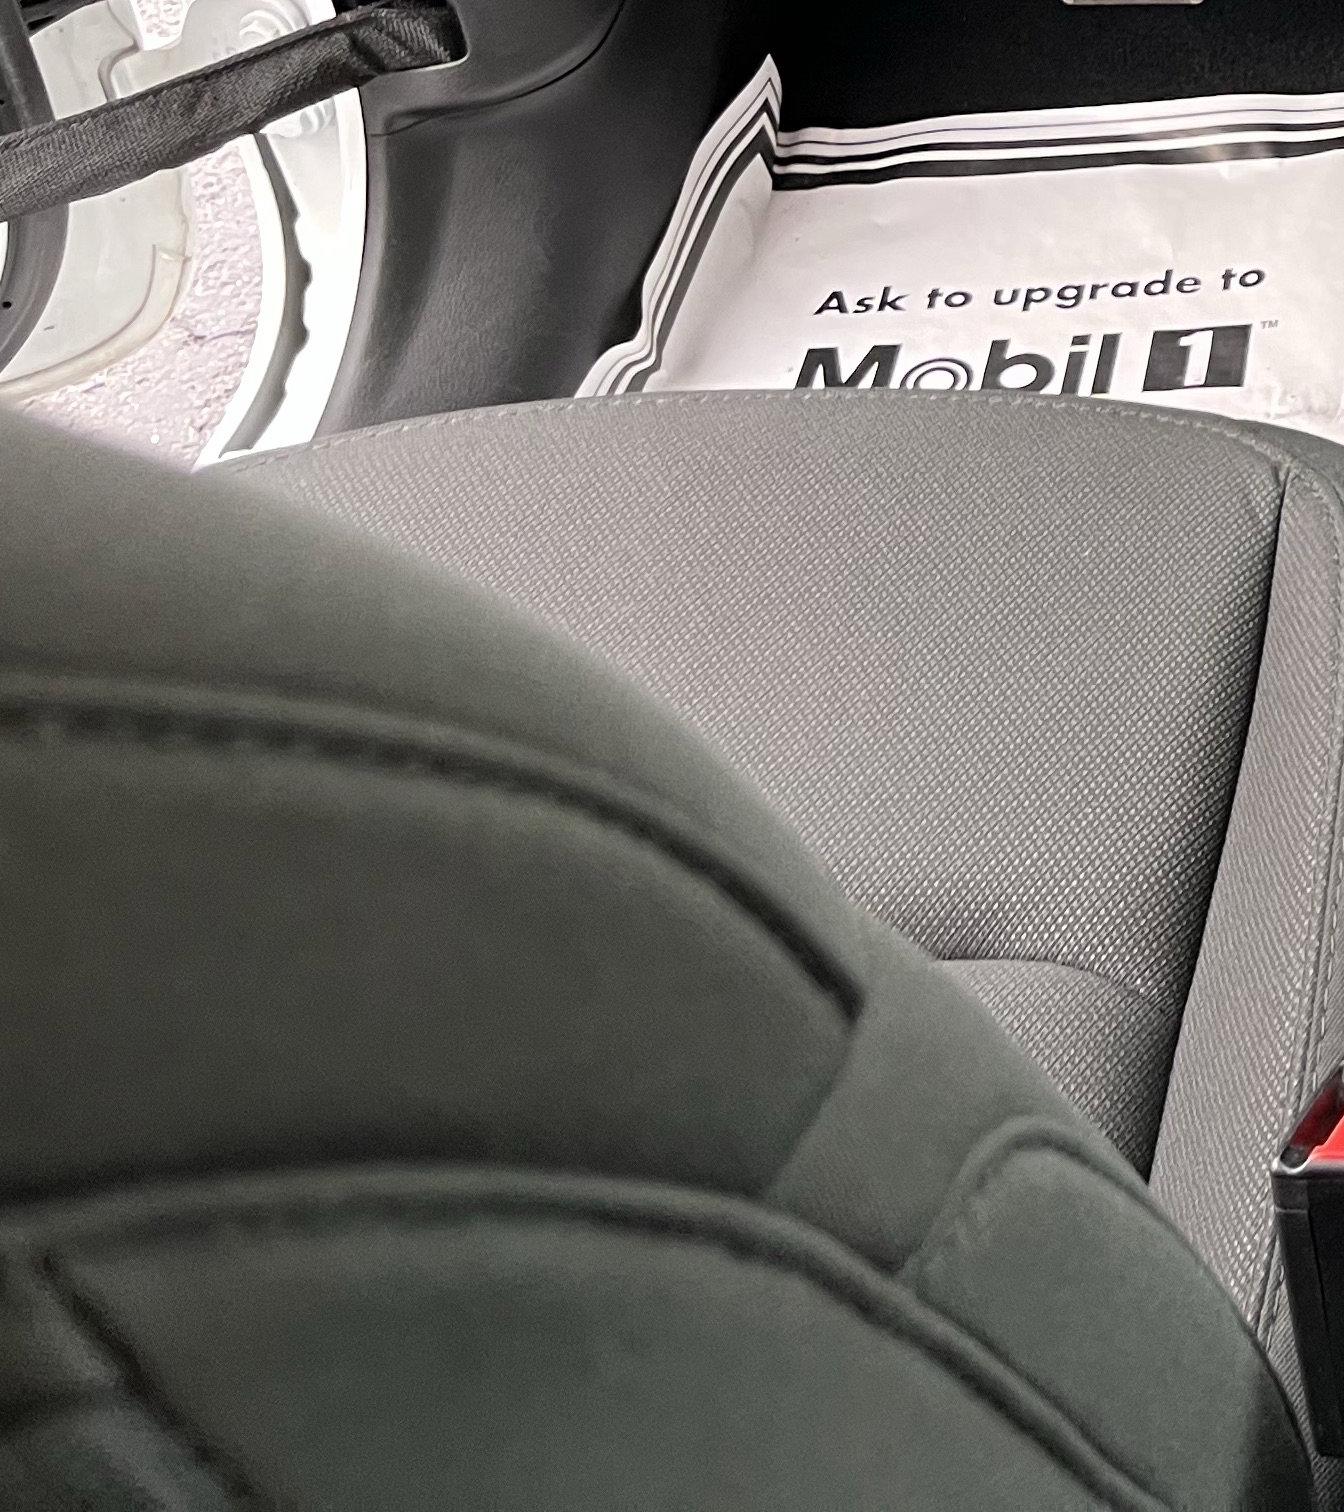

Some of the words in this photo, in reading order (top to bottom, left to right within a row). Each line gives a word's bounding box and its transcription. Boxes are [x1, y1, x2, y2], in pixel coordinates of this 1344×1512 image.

[812, 286, 909, 316] Ask
[926, 286, 974, 310] to
[992, 269, 1202, 312] upgrade
[1220, 267, 1267, 291] to
[794, 331, 1124, 397] Mobil
